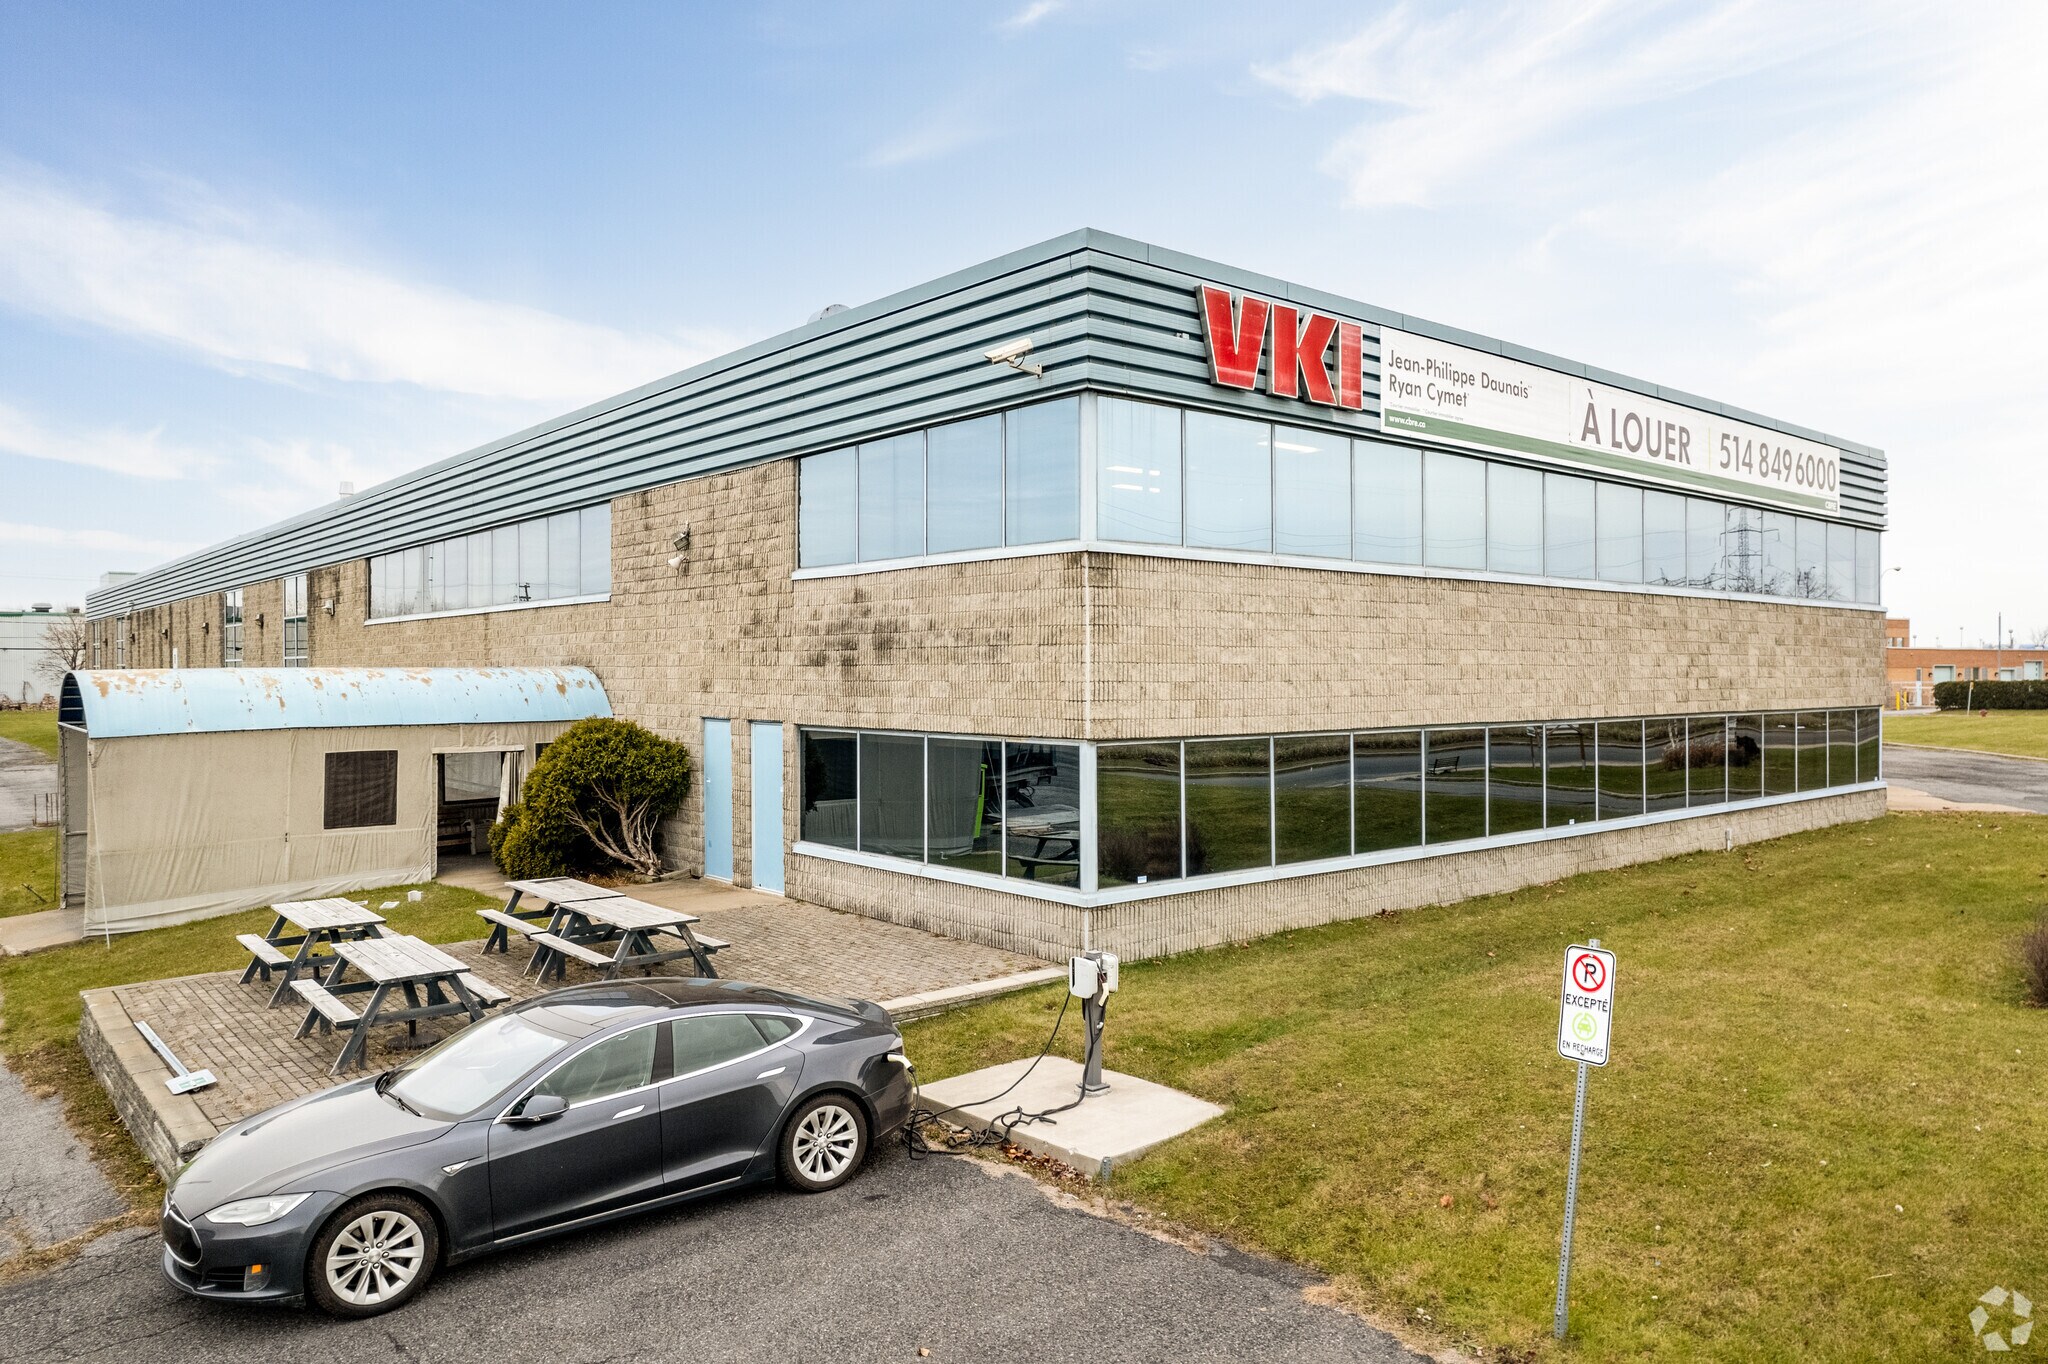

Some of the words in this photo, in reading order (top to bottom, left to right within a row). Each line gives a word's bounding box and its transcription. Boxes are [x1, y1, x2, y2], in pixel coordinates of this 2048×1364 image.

[1197, 284, 1363, 411] VKI
[1388, 350, 1475, 388] Jean-Philippe
[1389, 373, 1422, 398] Ryan
[1581, 388, 1601, 445] À
[1611, 408, 1691, 465] LOUER
[1719, 432, 1754, 475] 514
[1565, 993, 1608, 1013] EXCEPTÉ
[1562, 1040, 1571, 1049] EN
[1572, 1042, 1604, 1058] RECHARGE
